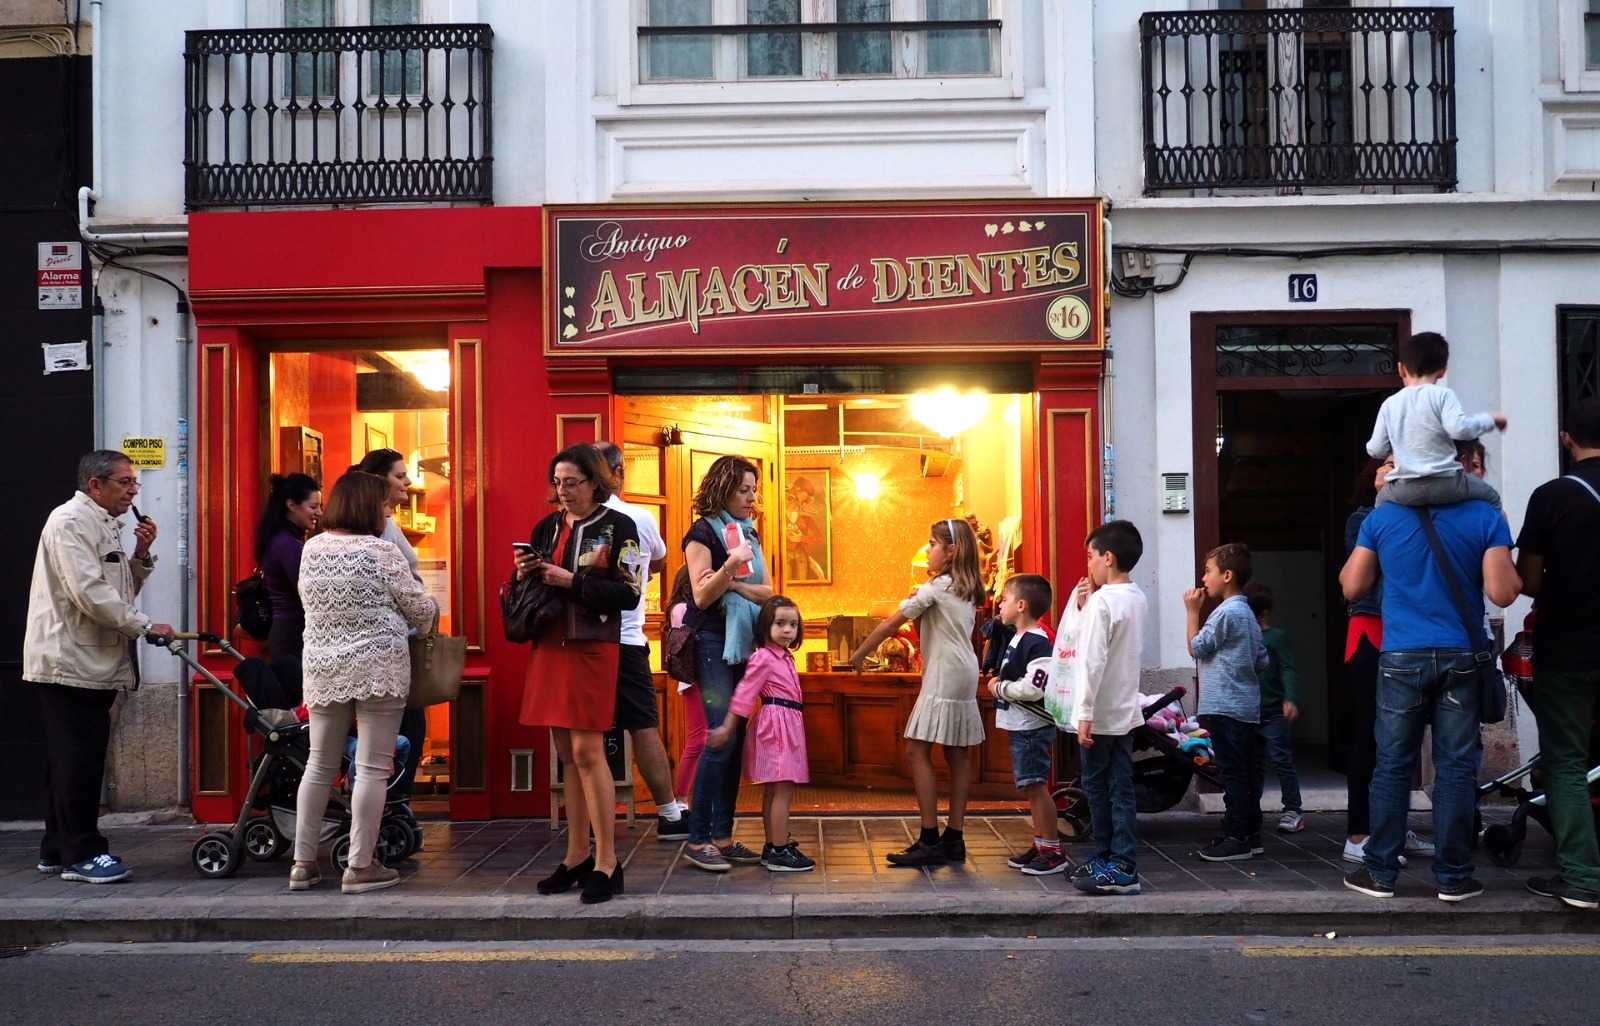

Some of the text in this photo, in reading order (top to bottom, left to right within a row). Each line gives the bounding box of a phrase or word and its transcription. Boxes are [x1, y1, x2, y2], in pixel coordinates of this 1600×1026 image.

[580, 221, 691, 263] Antiguo
[41, 272, 79, 281] Alarma
[586, 238, 1081, 334] ALMACÉN de DIENTES
[1291, 277, 1315, 299] 16
[1061, 305, 1080, 328] 16
[123, 438, 163, 449] COMPRO PISO
